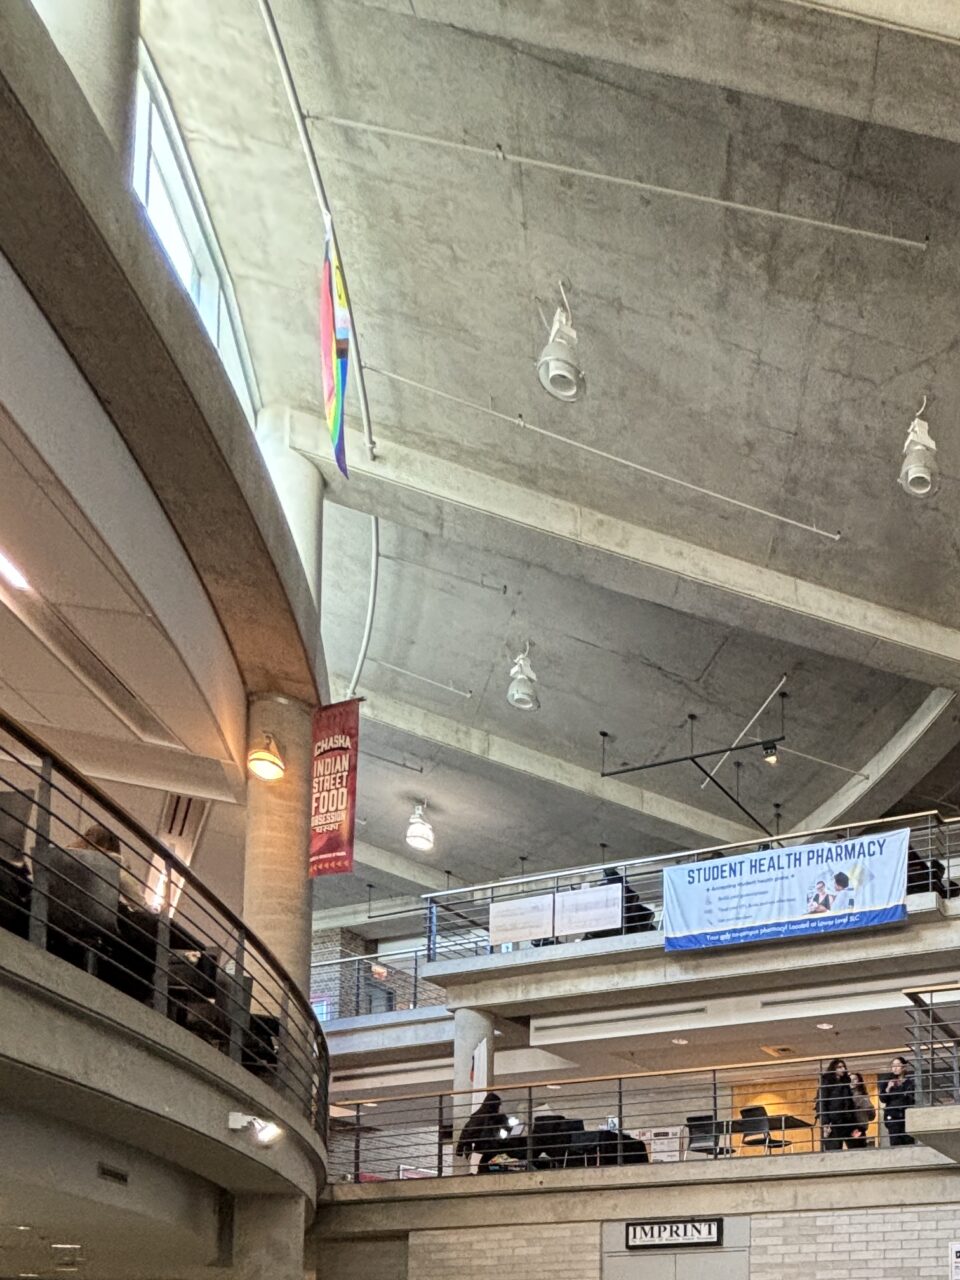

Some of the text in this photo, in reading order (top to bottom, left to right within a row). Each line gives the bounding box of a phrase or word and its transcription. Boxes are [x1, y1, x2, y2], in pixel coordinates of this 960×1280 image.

[313, 753, 350, 777] INDIAN
[312, 771, 348, 793] STREET
[311, 788, 348, 816] FOOD
[687, 839, 887, 885] STUDENT HEALTH PHARMACY
[631, 1222, 717, 1240] IMPRINT
